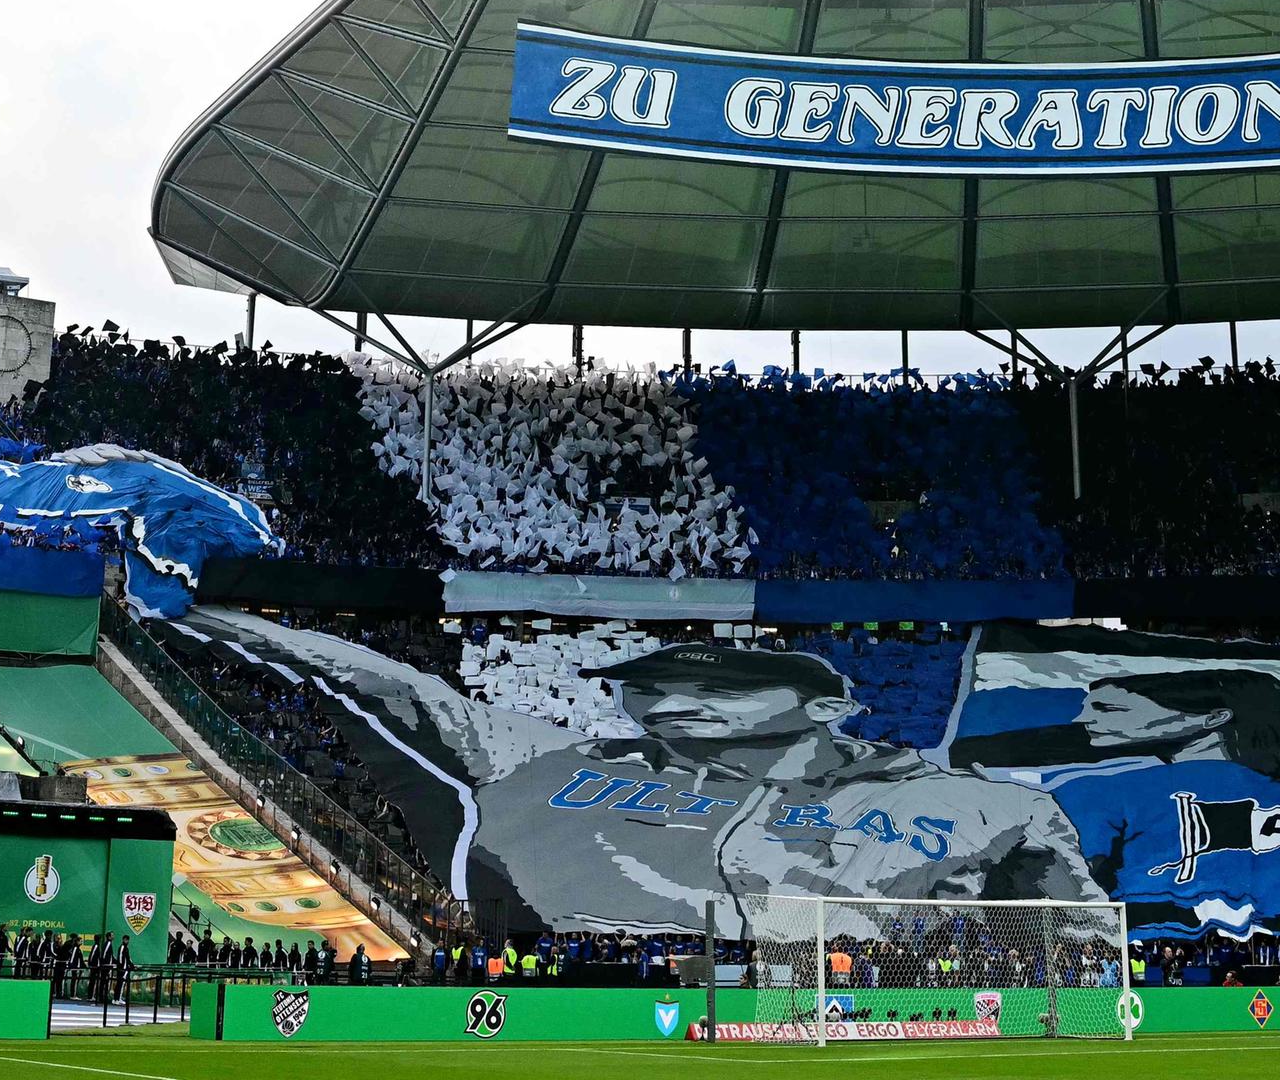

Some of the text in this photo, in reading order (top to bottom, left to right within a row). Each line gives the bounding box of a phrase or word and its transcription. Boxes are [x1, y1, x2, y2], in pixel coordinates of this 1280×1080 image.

[550, 57, 678, 129] ZU
[466, 995, 505, 1033] 96
[856, 1023, 899, 1038] ERGO
[903, 1022, 999, 1038] FLYERALARM
